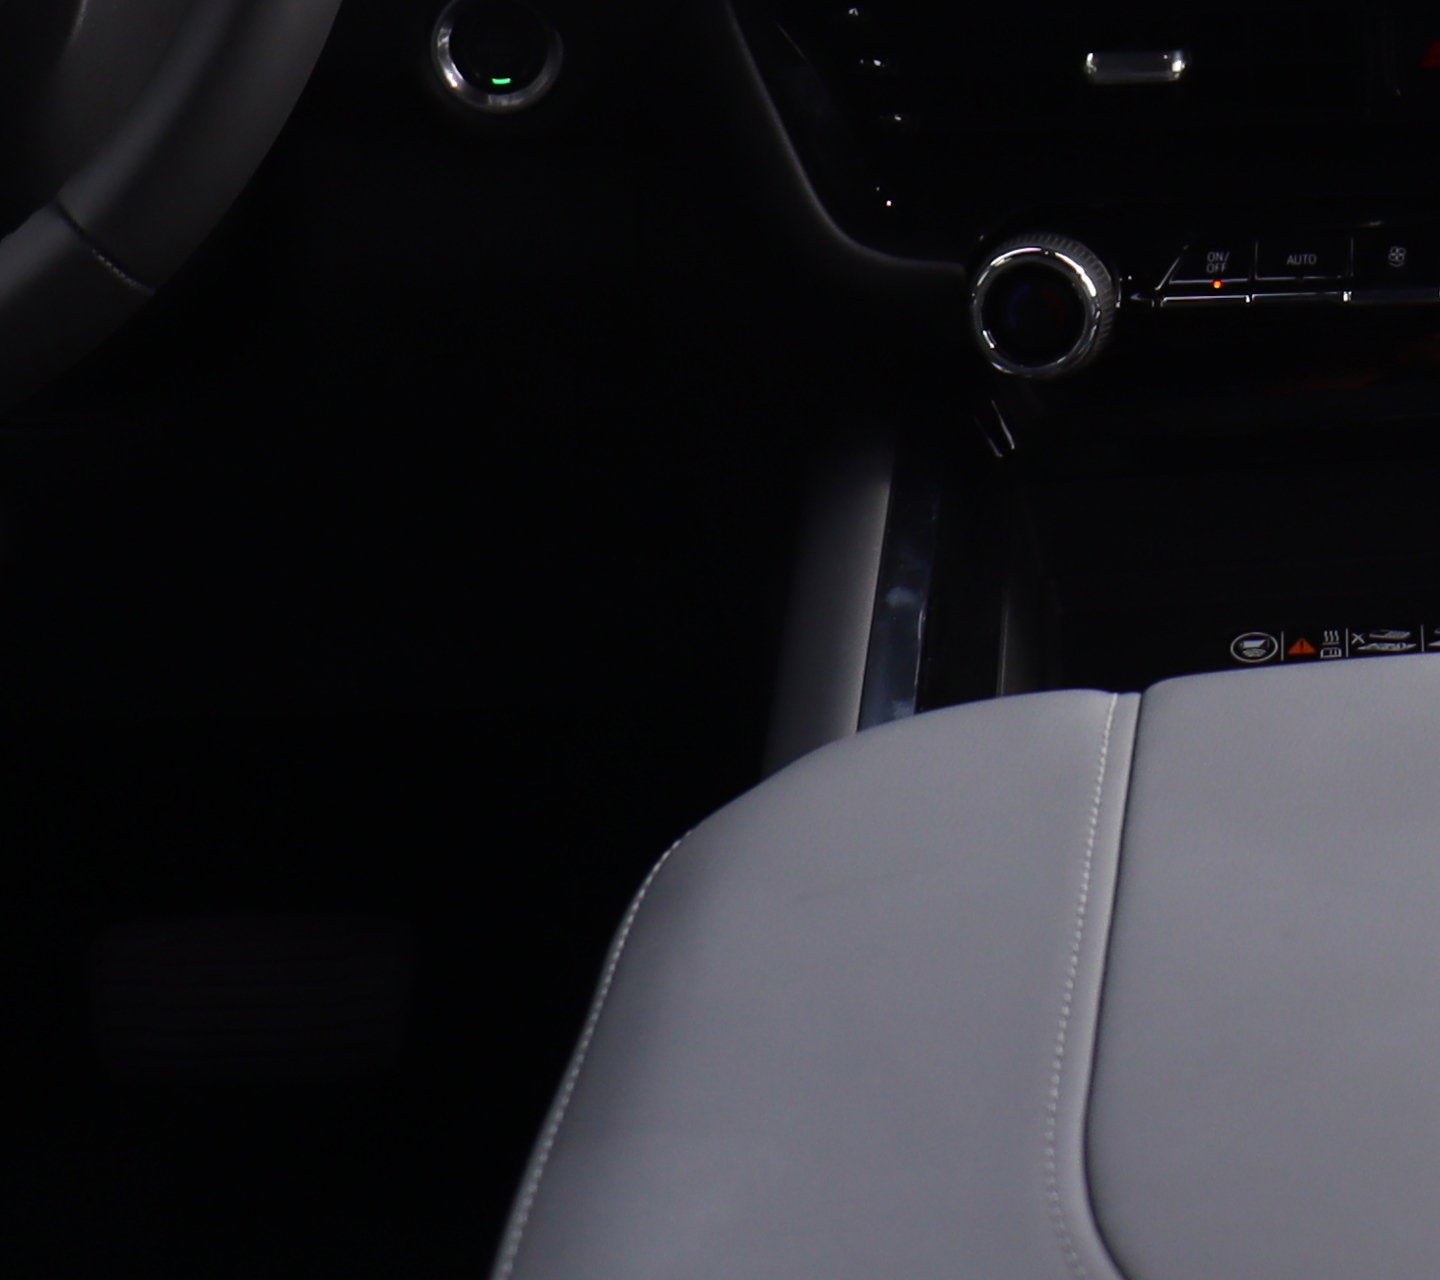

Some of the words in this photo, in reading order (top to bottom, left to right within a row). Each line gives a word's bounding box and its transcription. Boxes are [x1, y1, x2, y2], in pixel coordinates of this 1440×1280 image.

[1205, 251, 1230, 264] ON/
[1285, 252, 1318, 267] AUTO
[1205, 262, 1229, 275] OFF
